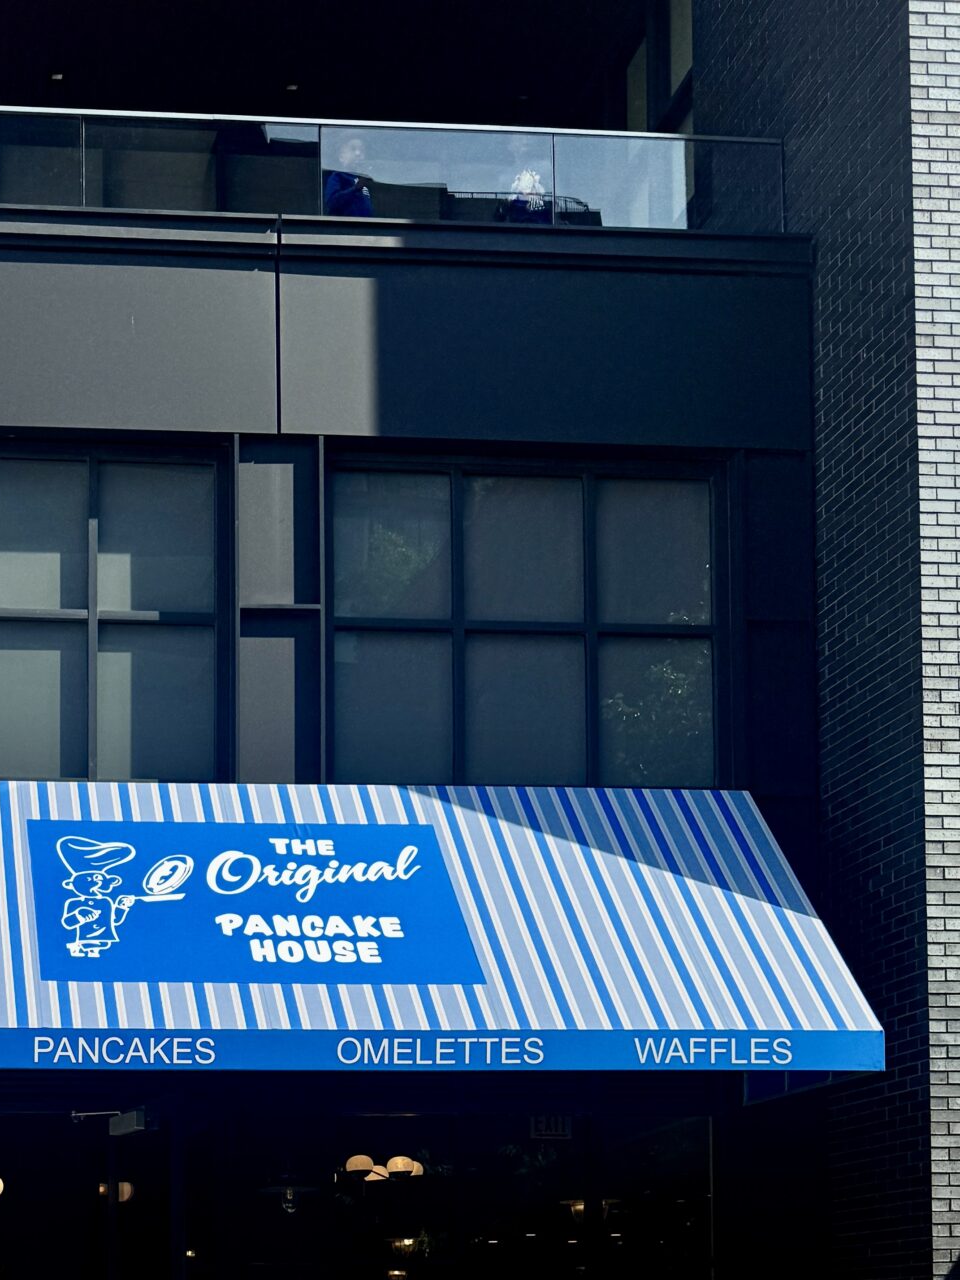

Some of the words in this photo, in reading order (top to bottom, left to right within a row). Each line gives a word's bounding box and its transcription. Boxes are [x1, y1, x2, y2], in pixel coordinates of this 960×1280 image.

[268, 837, 335, 856] THE
[206, 845, 421, 903] Original
[214, 912, 404, 938] PANCAKE
[249, 939, 382, 963] HOUSE
[33, 1036, 216, 1064] PANCAKES
[336, 1036, 545, 1065] OMELETTES
[634, 1037, 793, 1065] WAFFLES
